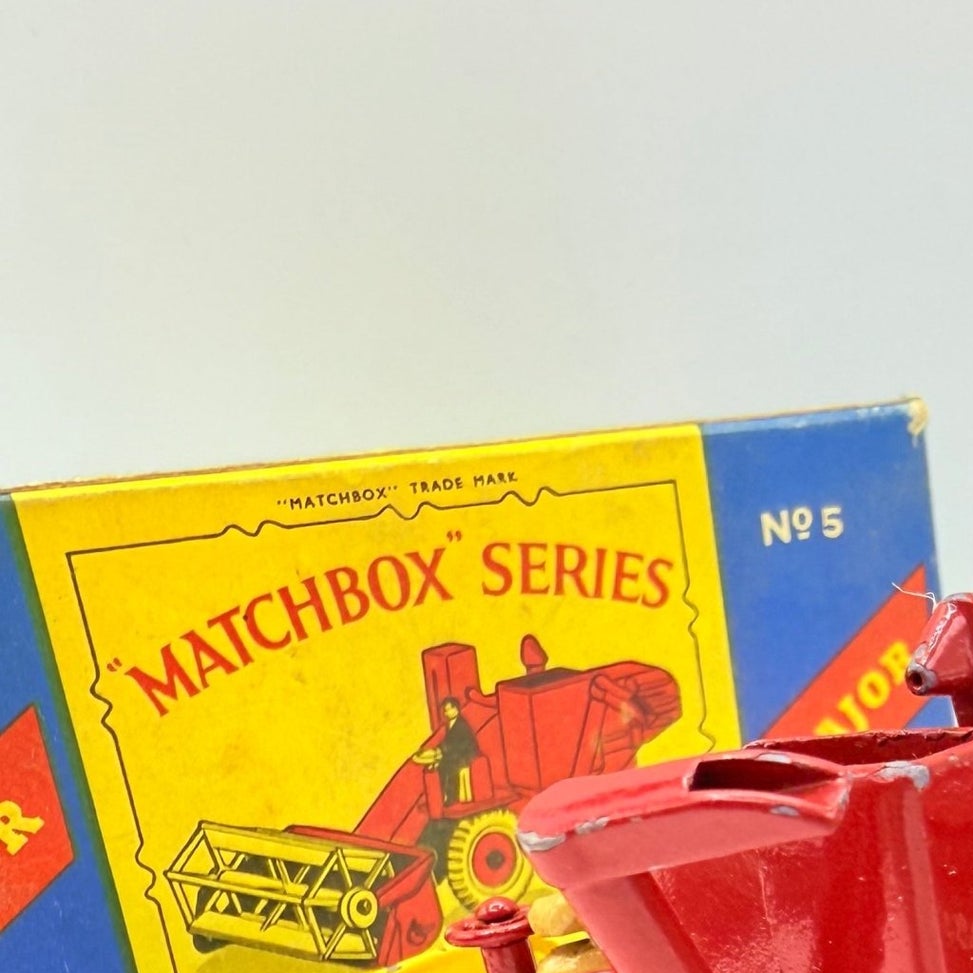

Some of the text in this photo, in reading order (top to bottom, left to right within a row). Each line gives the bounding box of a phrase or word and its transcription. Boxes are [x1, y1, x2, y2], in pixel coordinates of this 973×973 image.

[409, 477, 463, 495] TRADE
[473, 471, 518, 489] MARK
[821, 505, 844, 539] 5
[480, 541, 675, 609] SERIES
